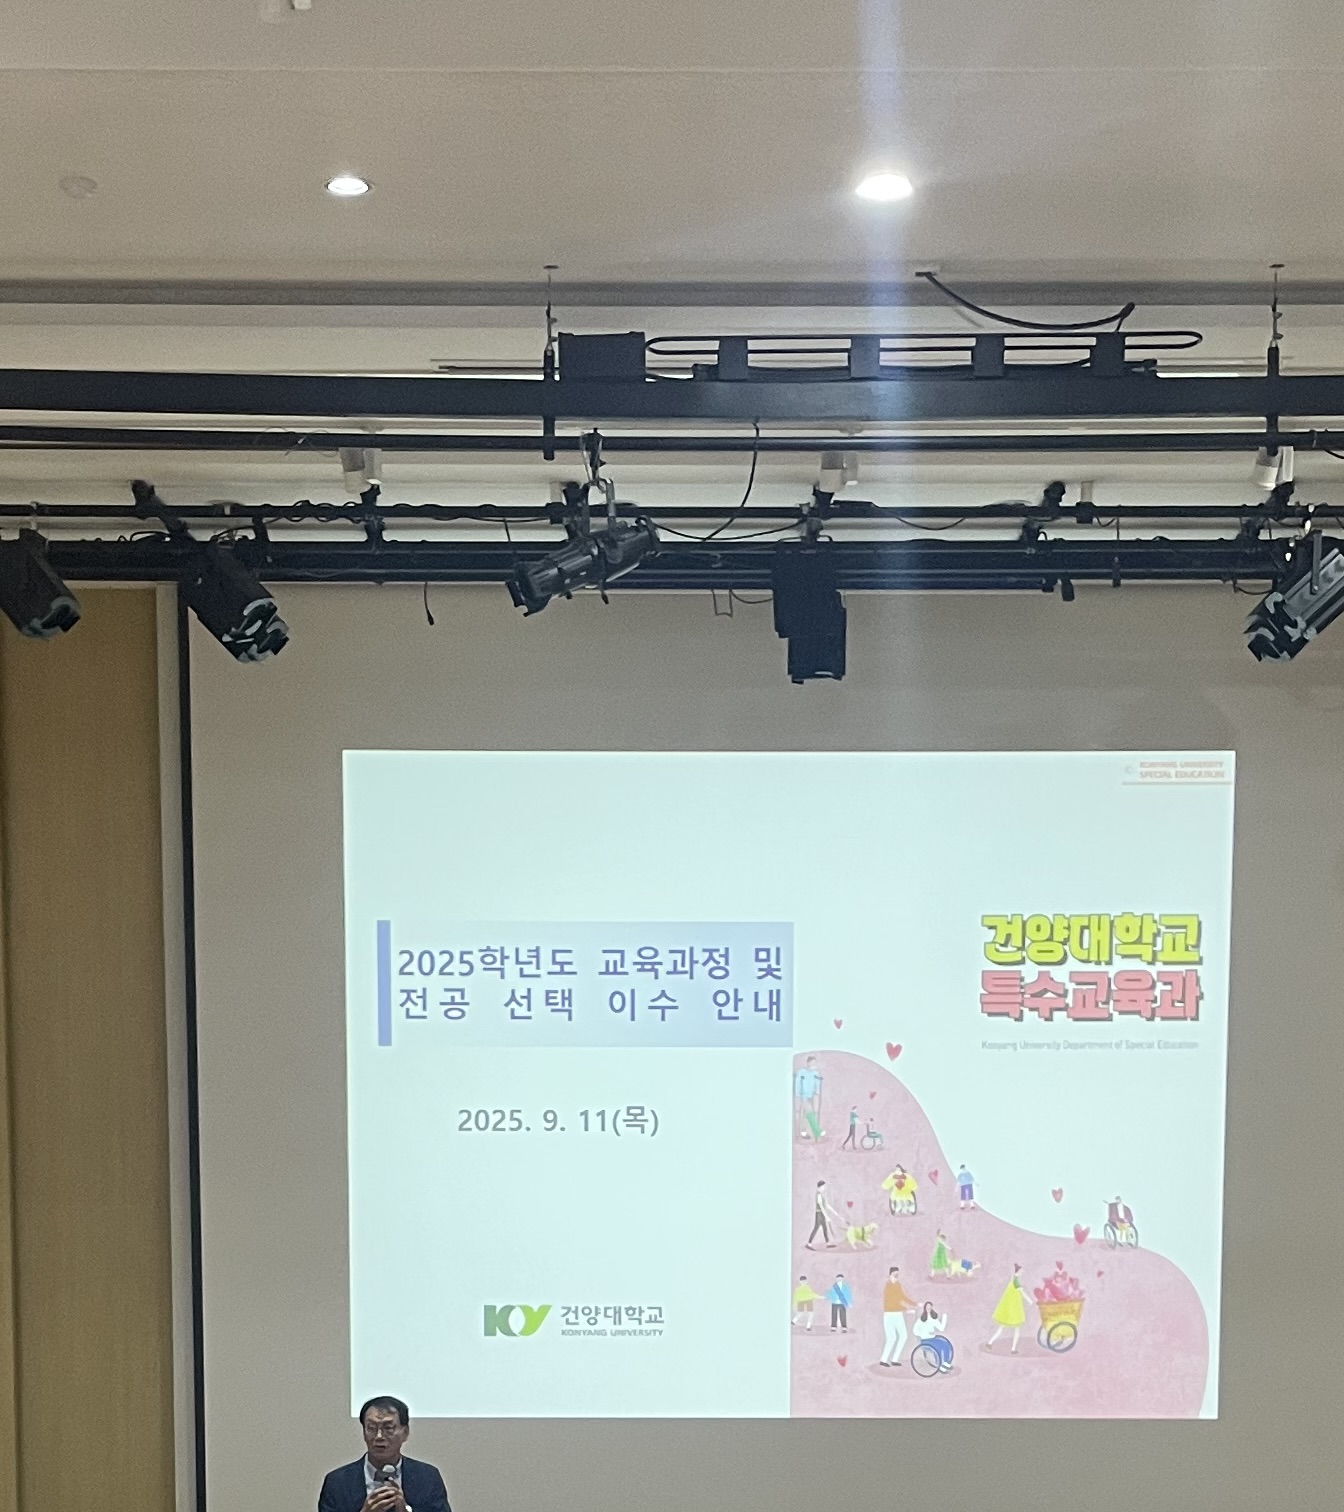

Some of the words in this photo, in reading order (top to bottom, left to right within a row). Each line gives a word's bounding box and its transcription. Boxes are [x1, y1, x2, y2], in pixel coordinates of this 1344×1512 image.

[981, 912, 1203, 965] 건양대학교
[398, 946, 578, 980] 2025학년도
[597, 946, 732, 980] 교육과정
[754, 946, 783, 980] 및
[399, 987, 470, 1020] 전공
[503, 987, 574, 1021] 선택
[608, 987, 680, 1022] 이수
[712, 987, 782, 1022] 안내
[980, 969, 1204, 1021] 특수교육과
[458, 1109, 531, 1131] 2025.
[543, 1109, 566, 1131] 9.
[579, 1106, 659, 1136] 11(목)
[561, 1305, 664, 1326] 건양대학교
